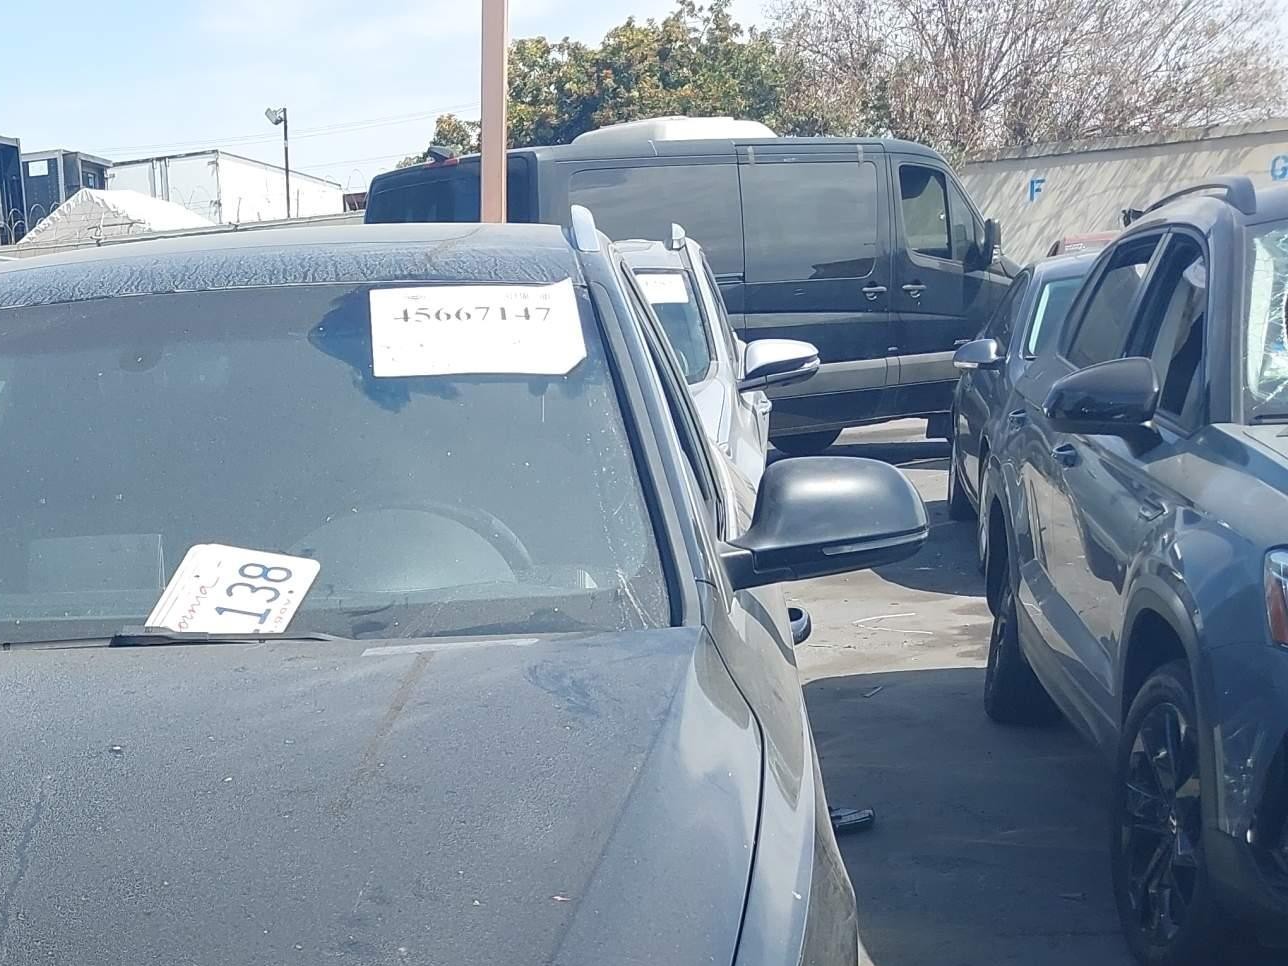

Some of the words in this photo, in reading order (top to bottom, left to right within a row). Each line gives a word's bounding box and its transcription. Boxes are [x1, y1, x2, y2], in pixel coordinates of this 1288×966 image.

[1029, 177, 1046, 203] F
[393, 306, 552, 323] 45667147
[214, 563, 293, 632] 138
